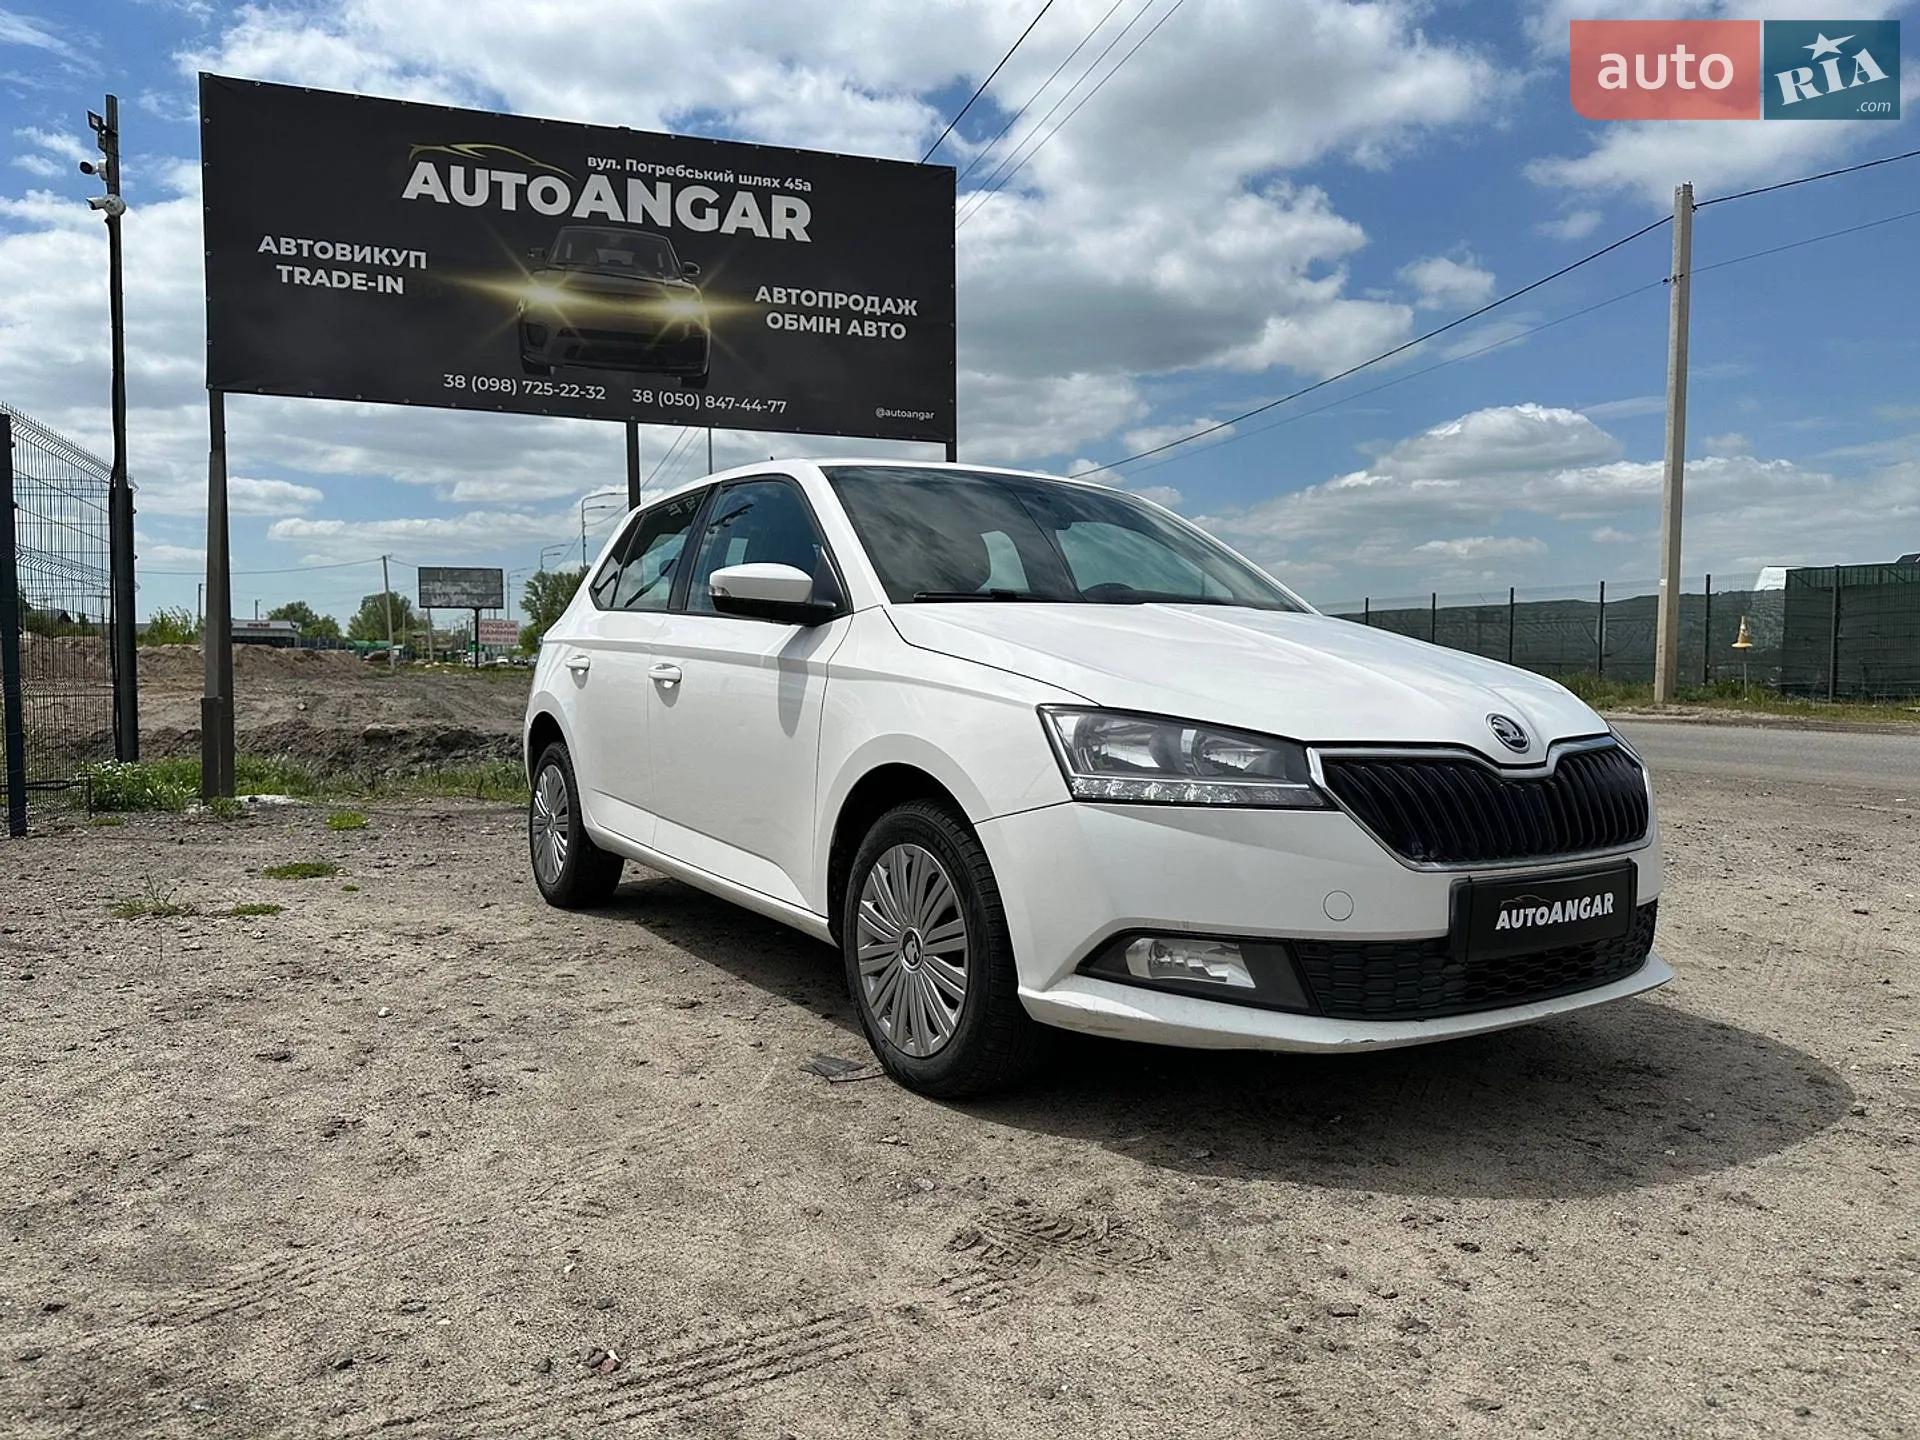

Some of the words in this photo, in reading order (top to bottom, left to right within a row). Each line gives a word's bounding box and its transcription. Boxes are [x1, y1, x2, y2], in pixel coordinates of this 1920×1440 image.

[587, 156, 621, 171] вул.
[625, 158, 735, 183] Погребський
[738, 174, 781, 189] шлях
[784, 177, 813, 192] 45а
[402, 160, 813, 243] AUTOANGAR
[257, 235, 427, 270] АВТОВИКУП
[276, 264, 405, 295] TRADE-IN
[755, 285, 918, 317] АВТОПРОДАЖ
[765, 311, 841, 335] ОБМІН
[846, 319, 907, 340] АВТО
[443, 373, 466, 389] 38
[471, 375, 517, 396] (098)
[522, 380, 606, 400] 725-22-32
[632, 388, 653, 403] 38
[658, 390, 700, 410] (050)
[705, 395, 787, 414] 847-44-77
[875, 407, 935, 421] @autoangar
[1495, 892, 1614, 931] AUTOANGAR
